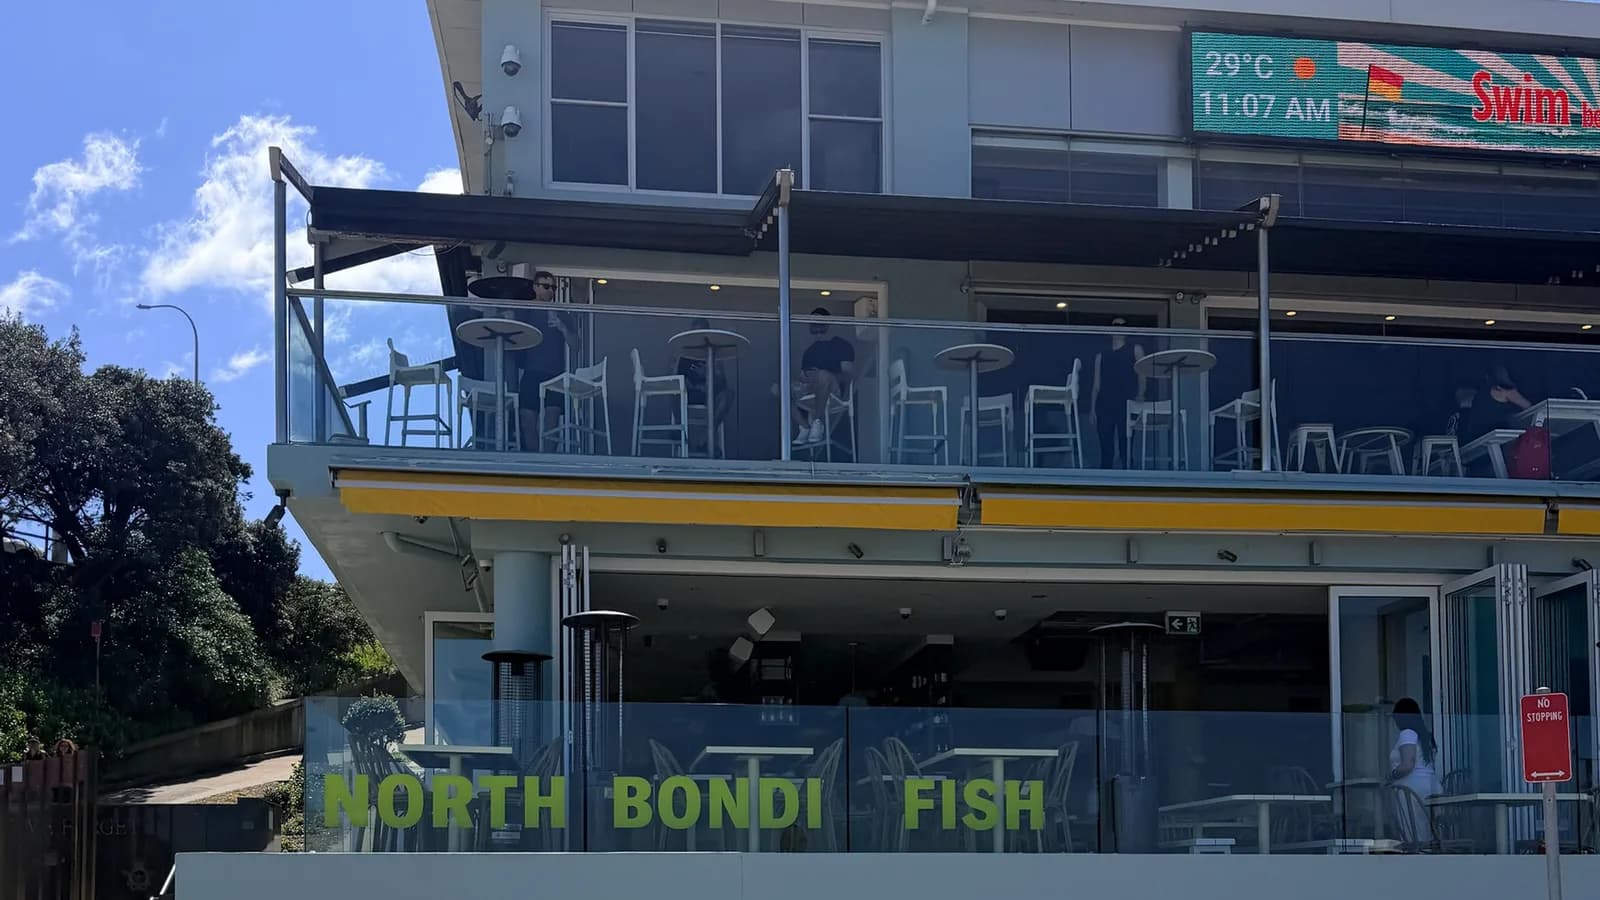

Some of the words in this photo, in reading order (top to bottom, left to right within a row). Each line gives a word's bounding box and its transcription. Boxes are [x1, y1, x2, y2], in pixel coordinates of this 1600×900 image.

[1206, 51, 1273, 79] 29°C
[1200, 91, 1276, 118] 11:07
[1285, 97, 1330, 121] AM
[1472, 70, 1571, 126] Swim
[1527, 711, 1563, 722] STOPPING
[1537, 697, 1550, 708] NO
[323, 774, 566, 829] NORTH
[613, 775, 822, 829] BONDI
[904, 778, 1044, 831] FISH
